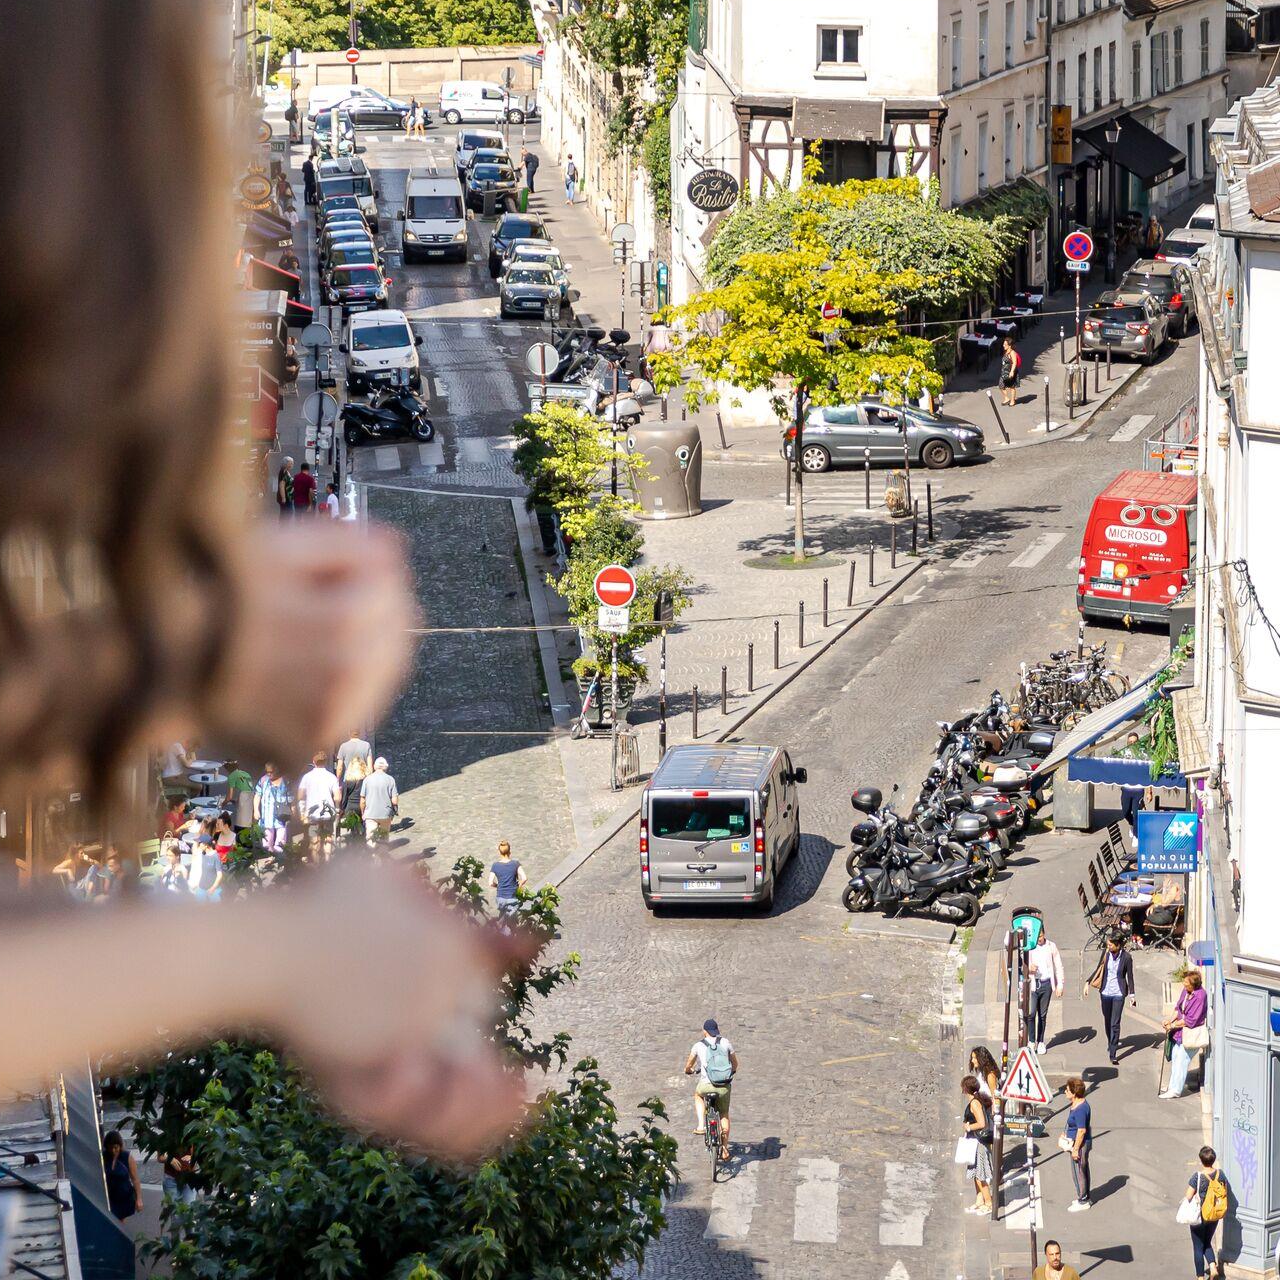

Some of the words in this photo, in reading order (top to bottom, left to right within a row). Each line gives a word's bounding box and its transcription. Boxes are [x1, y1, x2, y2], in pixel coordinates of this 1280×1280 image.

[691, 170, 735, 186] RESTAURANT
[691, 184, 736, 208] Basilic
[1108, 527, 1163, 543] MICROSOL
